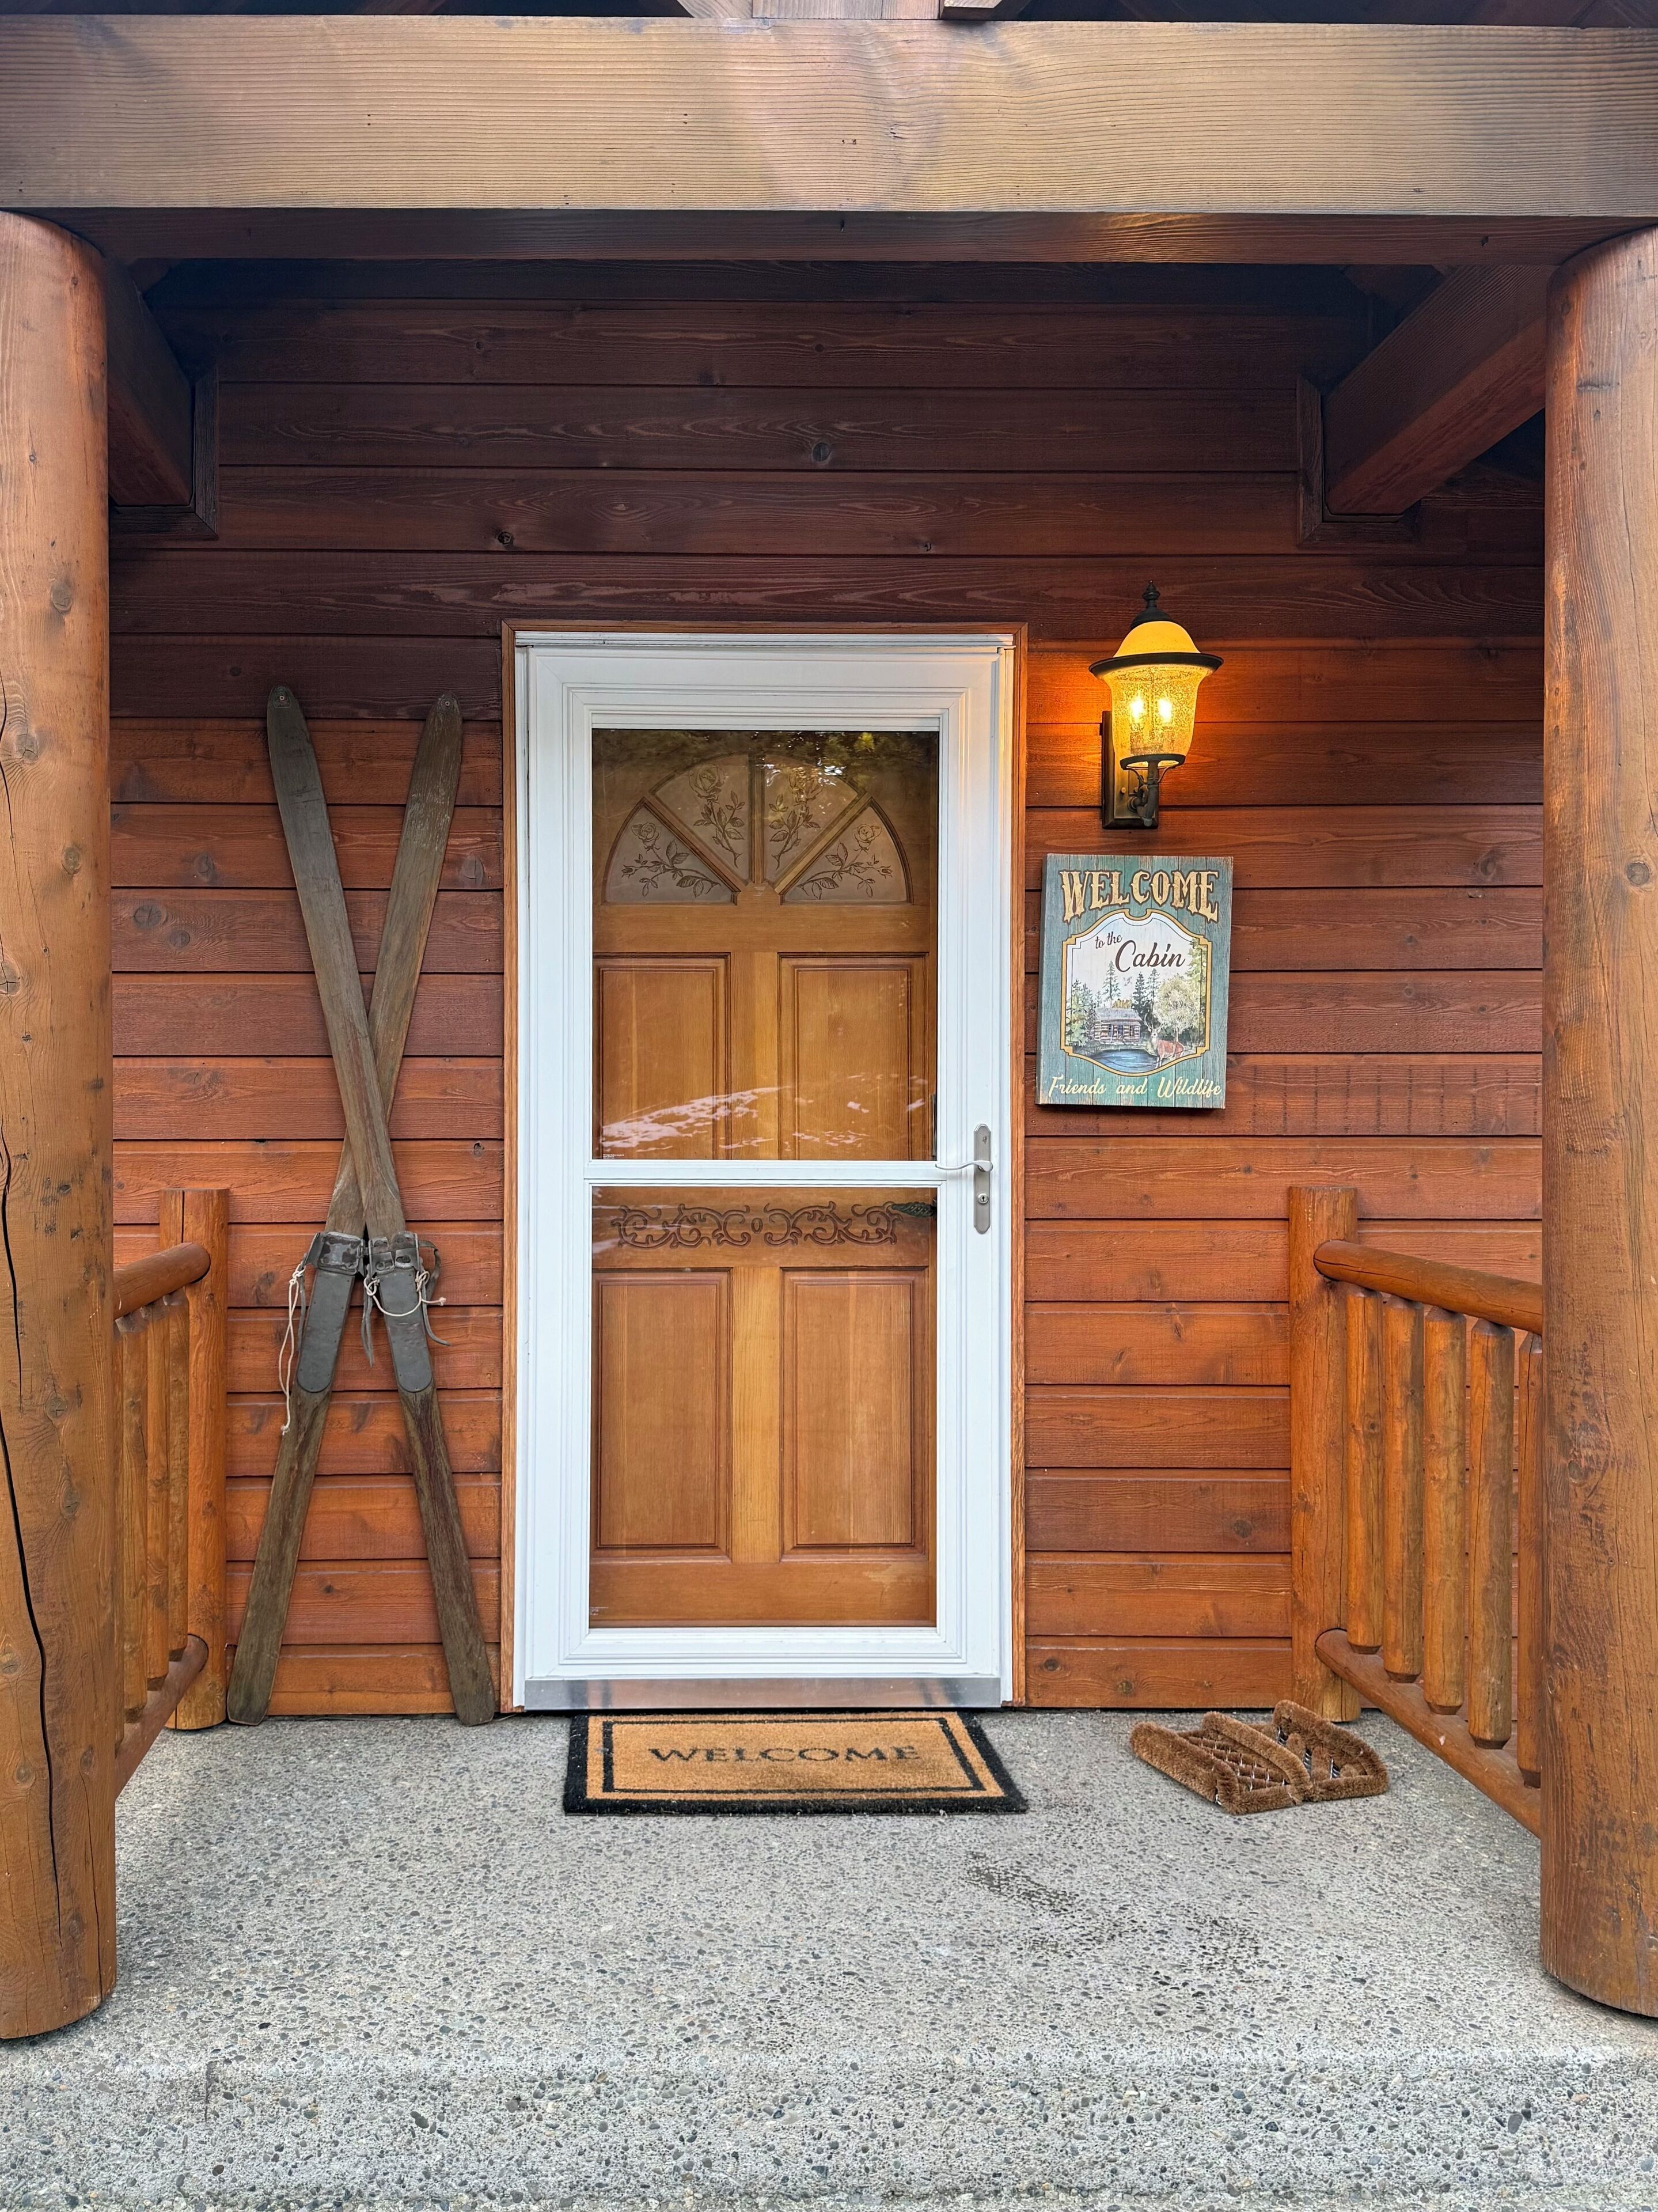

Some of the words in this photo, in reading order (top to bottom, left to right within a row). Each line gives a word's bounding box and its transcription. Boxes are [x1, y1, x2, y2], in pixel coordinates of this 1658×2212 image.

[1060, 870, 1219, 923] WELCOME
[1095, 935, 1105, 949] to
[1107, 931, 1123, 946] the
[1115, 940, 1186, 972] Cabin
[1048, 1073, 1106, 1097] Friends
[1116, 1079, 1148, 1094] and
[1156, 1077, 1223, 1099] Wildlife
[648, 1745, 922, 1763] WELCOME
